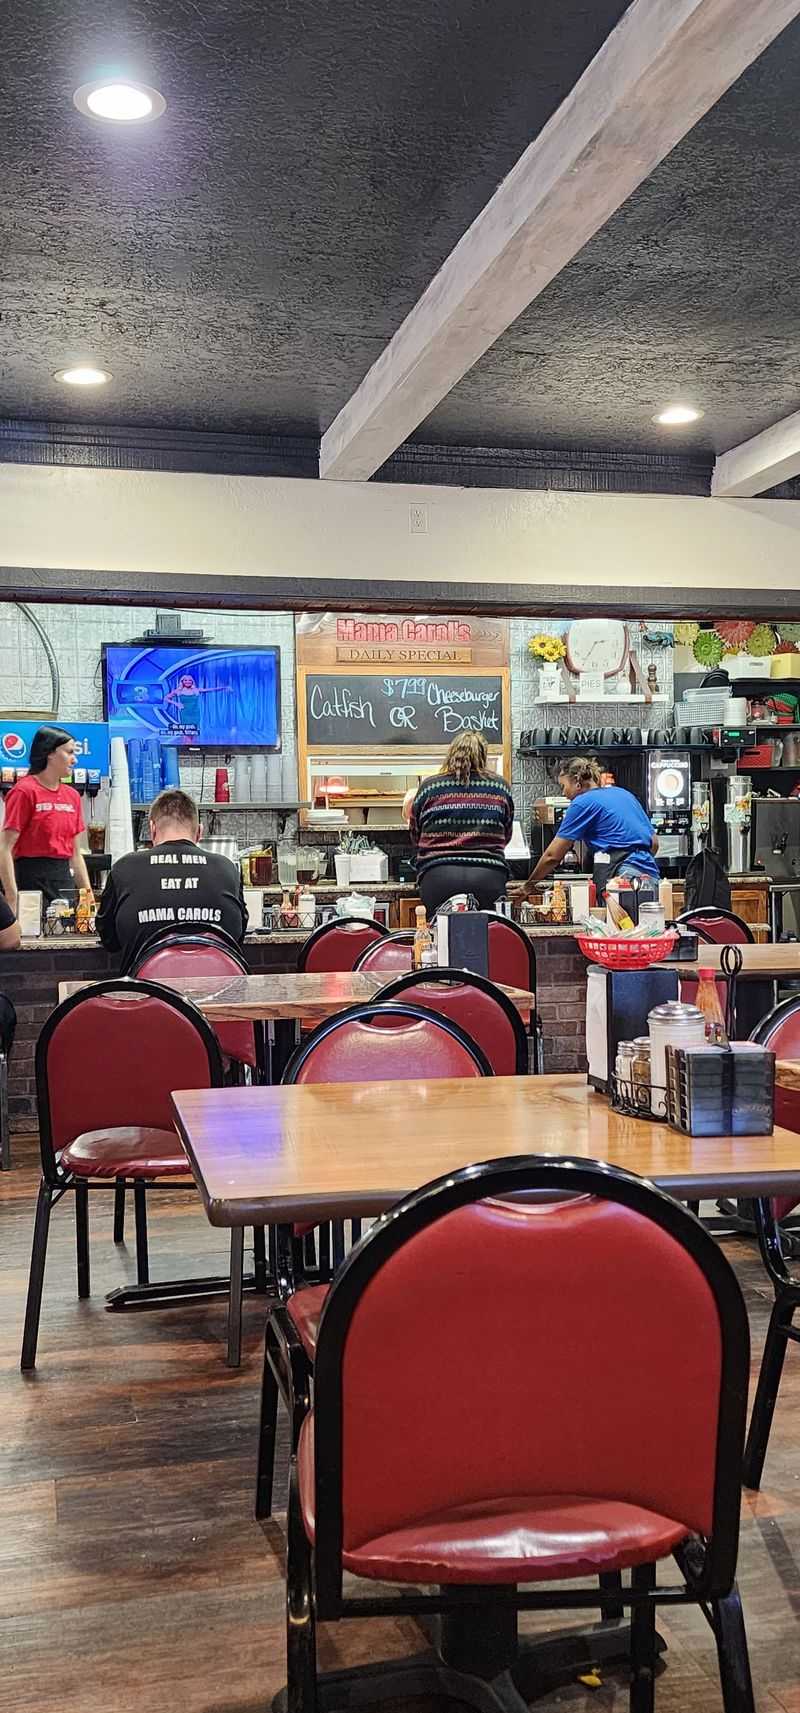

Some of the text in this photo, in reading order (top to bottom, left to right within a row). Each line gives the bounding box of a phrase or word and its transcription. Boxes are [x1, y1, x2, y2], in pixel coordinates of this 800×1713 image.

[336, 618, 471, 642] Mama Carol's
[350, 649, 461, 661] DAILY SPECIAL
[427, 682, 500, 708] Cheeseburger
[310, 684, 418, 729] Catfish OR
[434, 705, 499, 733] Basket
[150, 854, 207, 865] REAL MEN
[160, 877, 200, 890] EAT AT
[138, 907, 222, 924] MAMA CAROLS
